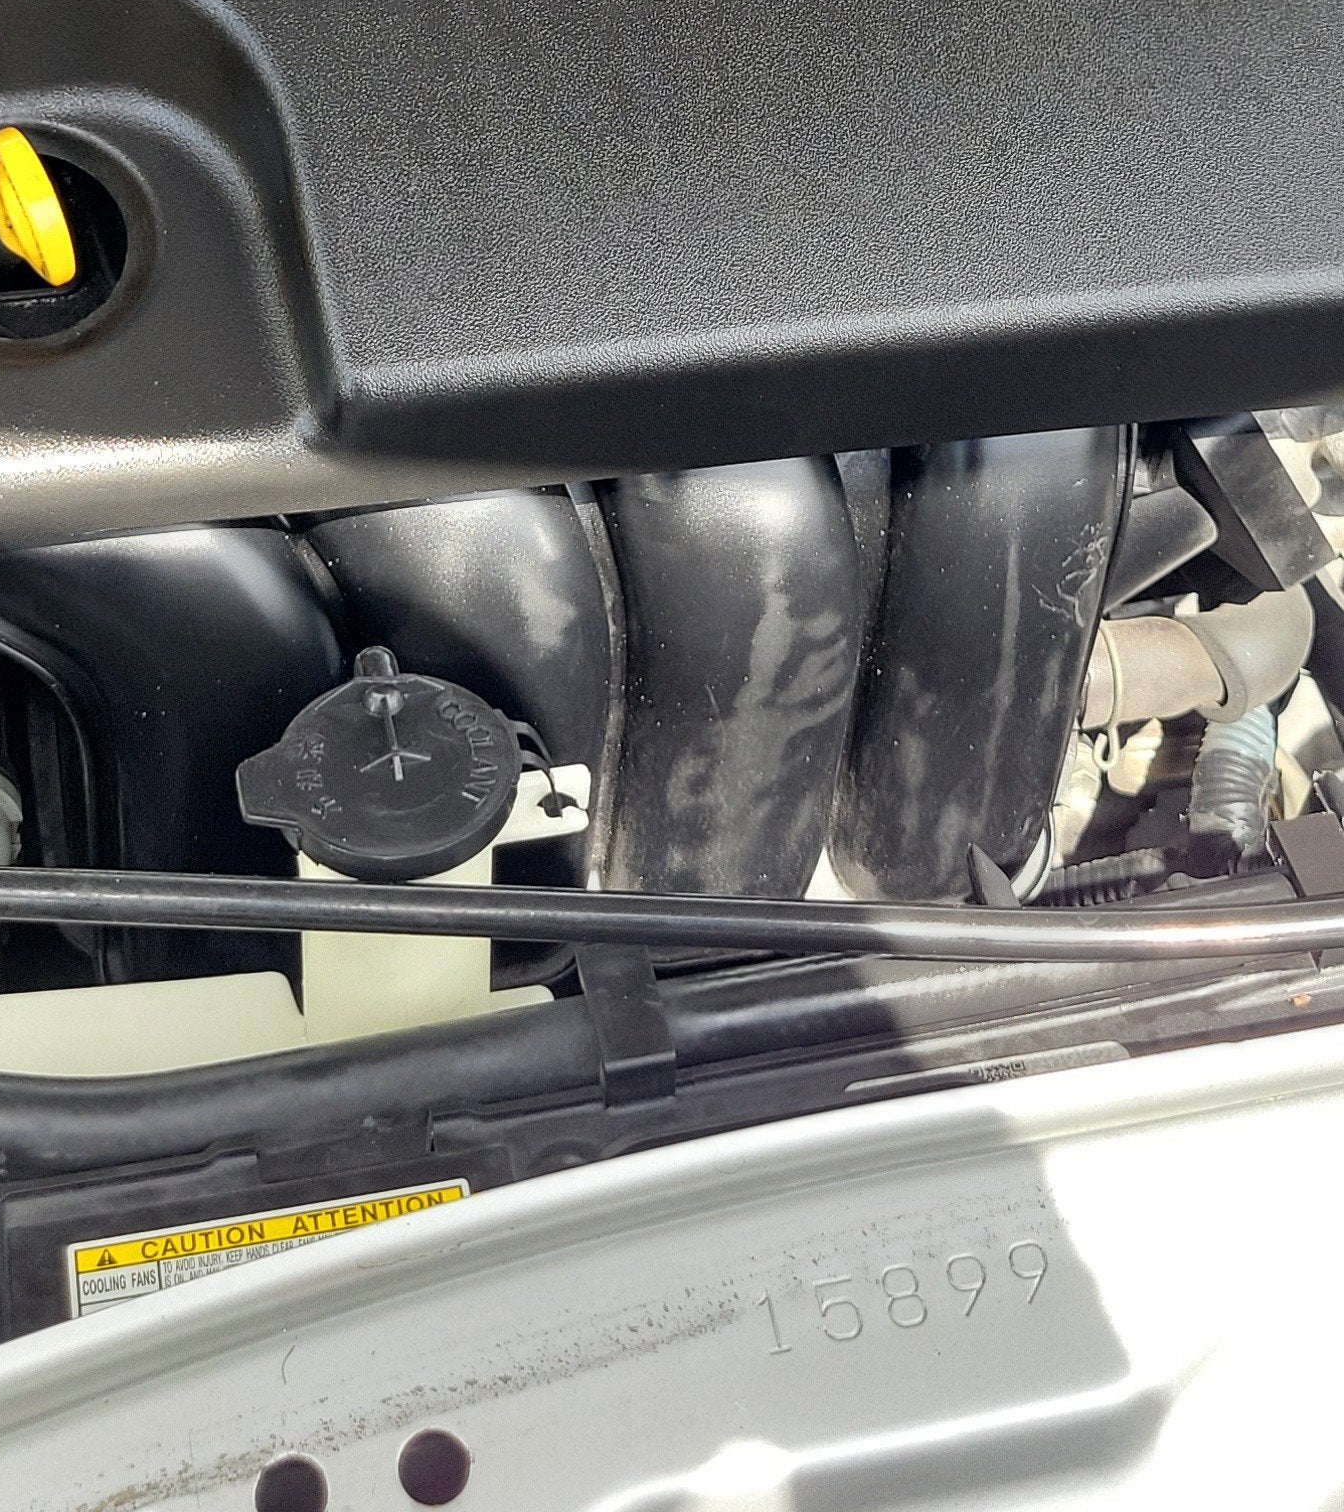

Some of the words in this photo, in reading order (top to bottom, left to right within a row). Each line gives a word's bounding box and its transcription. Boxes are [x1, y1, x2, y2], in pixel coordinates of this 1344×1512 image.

[438, 699, 499, 809] COOLANT
[141, 1222, 266, 1259] CAUTION
[292, 1191, 444, 1234] ATTENTION
[162, 1260, 173, 1273] TO
[175, 1257, 196, 1271] AVOID
[226, 1250, 244, 1263] KEEP
[246, 1245, 270, 1259] HANDS
[83, 1275, 126, 1295] COOLING
[131, 1269, 156, 1286] FANS
[757, 1239, 1049, 1355] 15899
